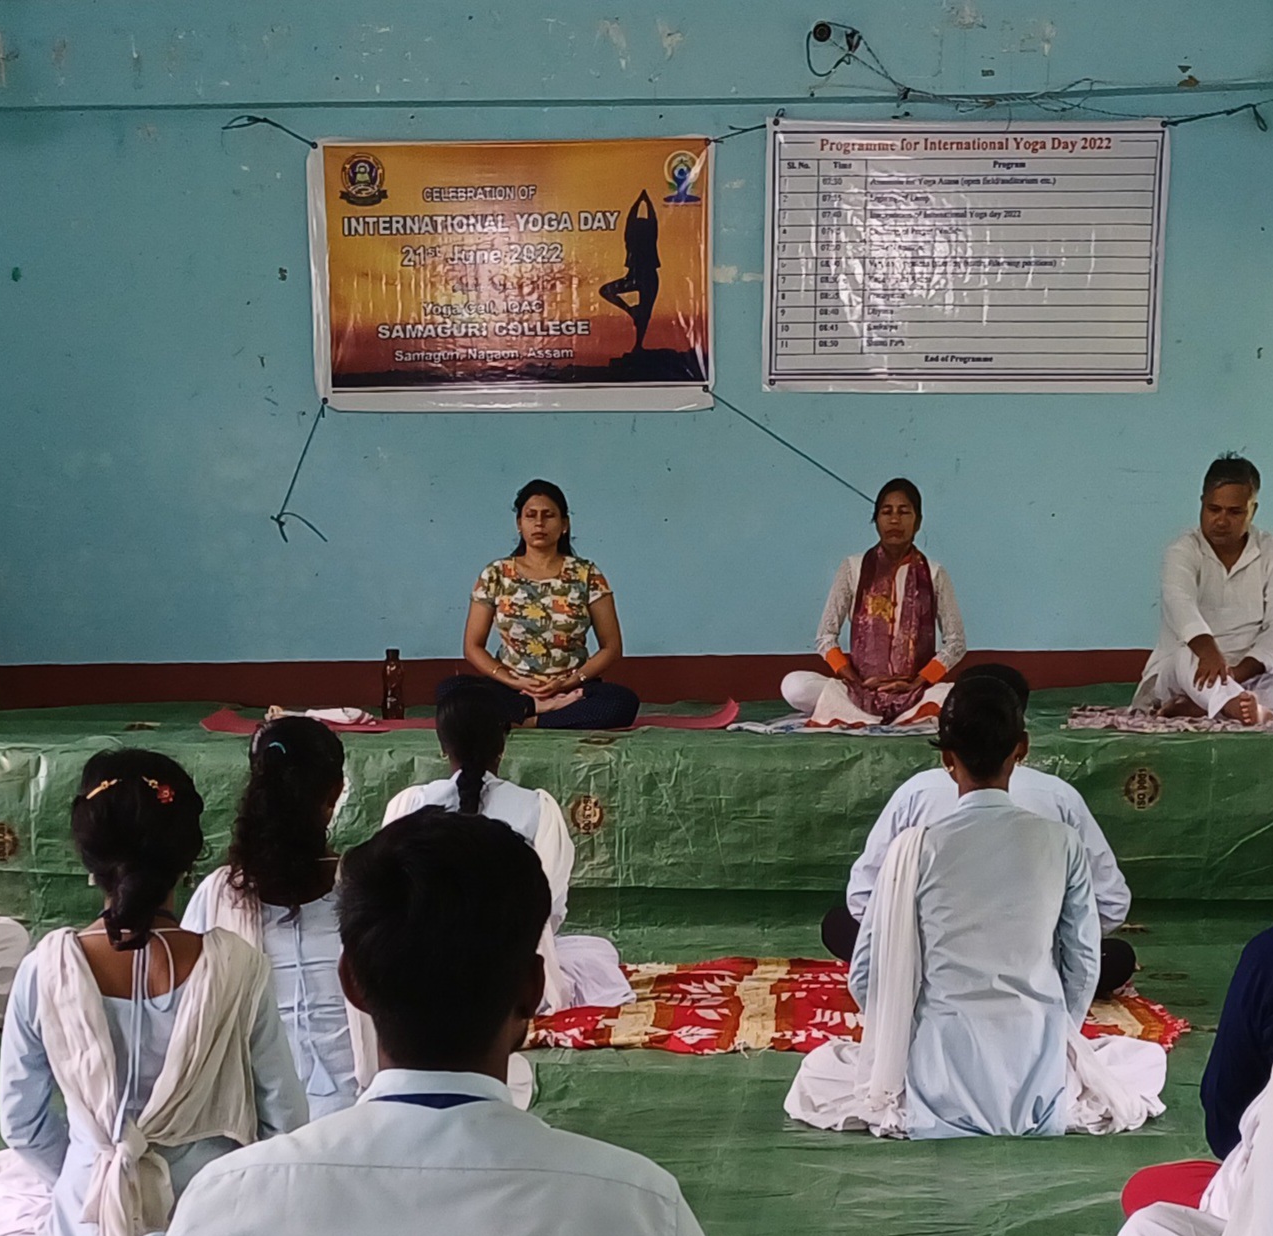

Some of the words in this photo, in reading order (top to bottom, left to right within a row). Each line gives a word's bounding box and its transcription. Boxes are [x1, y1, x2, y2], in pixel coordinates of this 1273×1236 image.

[820, 139, 899, 154] Programme
[900, 138, 920, 151] for
[924, 138, 1009, 151] International
[1013, 137, 1046, 153] Yoga
[1051, 137, 1077, 153] Day
[1081, 137, 1112, 150] 2022
[833, 161, 853, 169] Time
[992, 160, 1026, 170] Program
[917, 178, 937, 187] Yoga
[423, 186, 516, 201] CELEBRATION
[518, 185, 537, 200] OF
[343, 214, 509, 236] INTERNATIONAL
[515, 211, 574, 233] YOGA
[578, 210, 620, 231] DAY
[969, 211, 987, 219] Yoga
[989, 211, 1002, 219] day
[401, 246, 441, 267] 21st
[448, 246, 502, 265] June
[510, 243, 563, 264] 2022
[423, 301, 462, 318] Yoga
[503, 300, 544, 315] IQAC
[377, 322, 487, 340] SAMAGURI
[494, 320, 591, 337] COLLEGE
[527, 347, 574, 360] Assam
[950, 355, 993, 364] Programme
[1137, 793, 1146, 809] ISO
